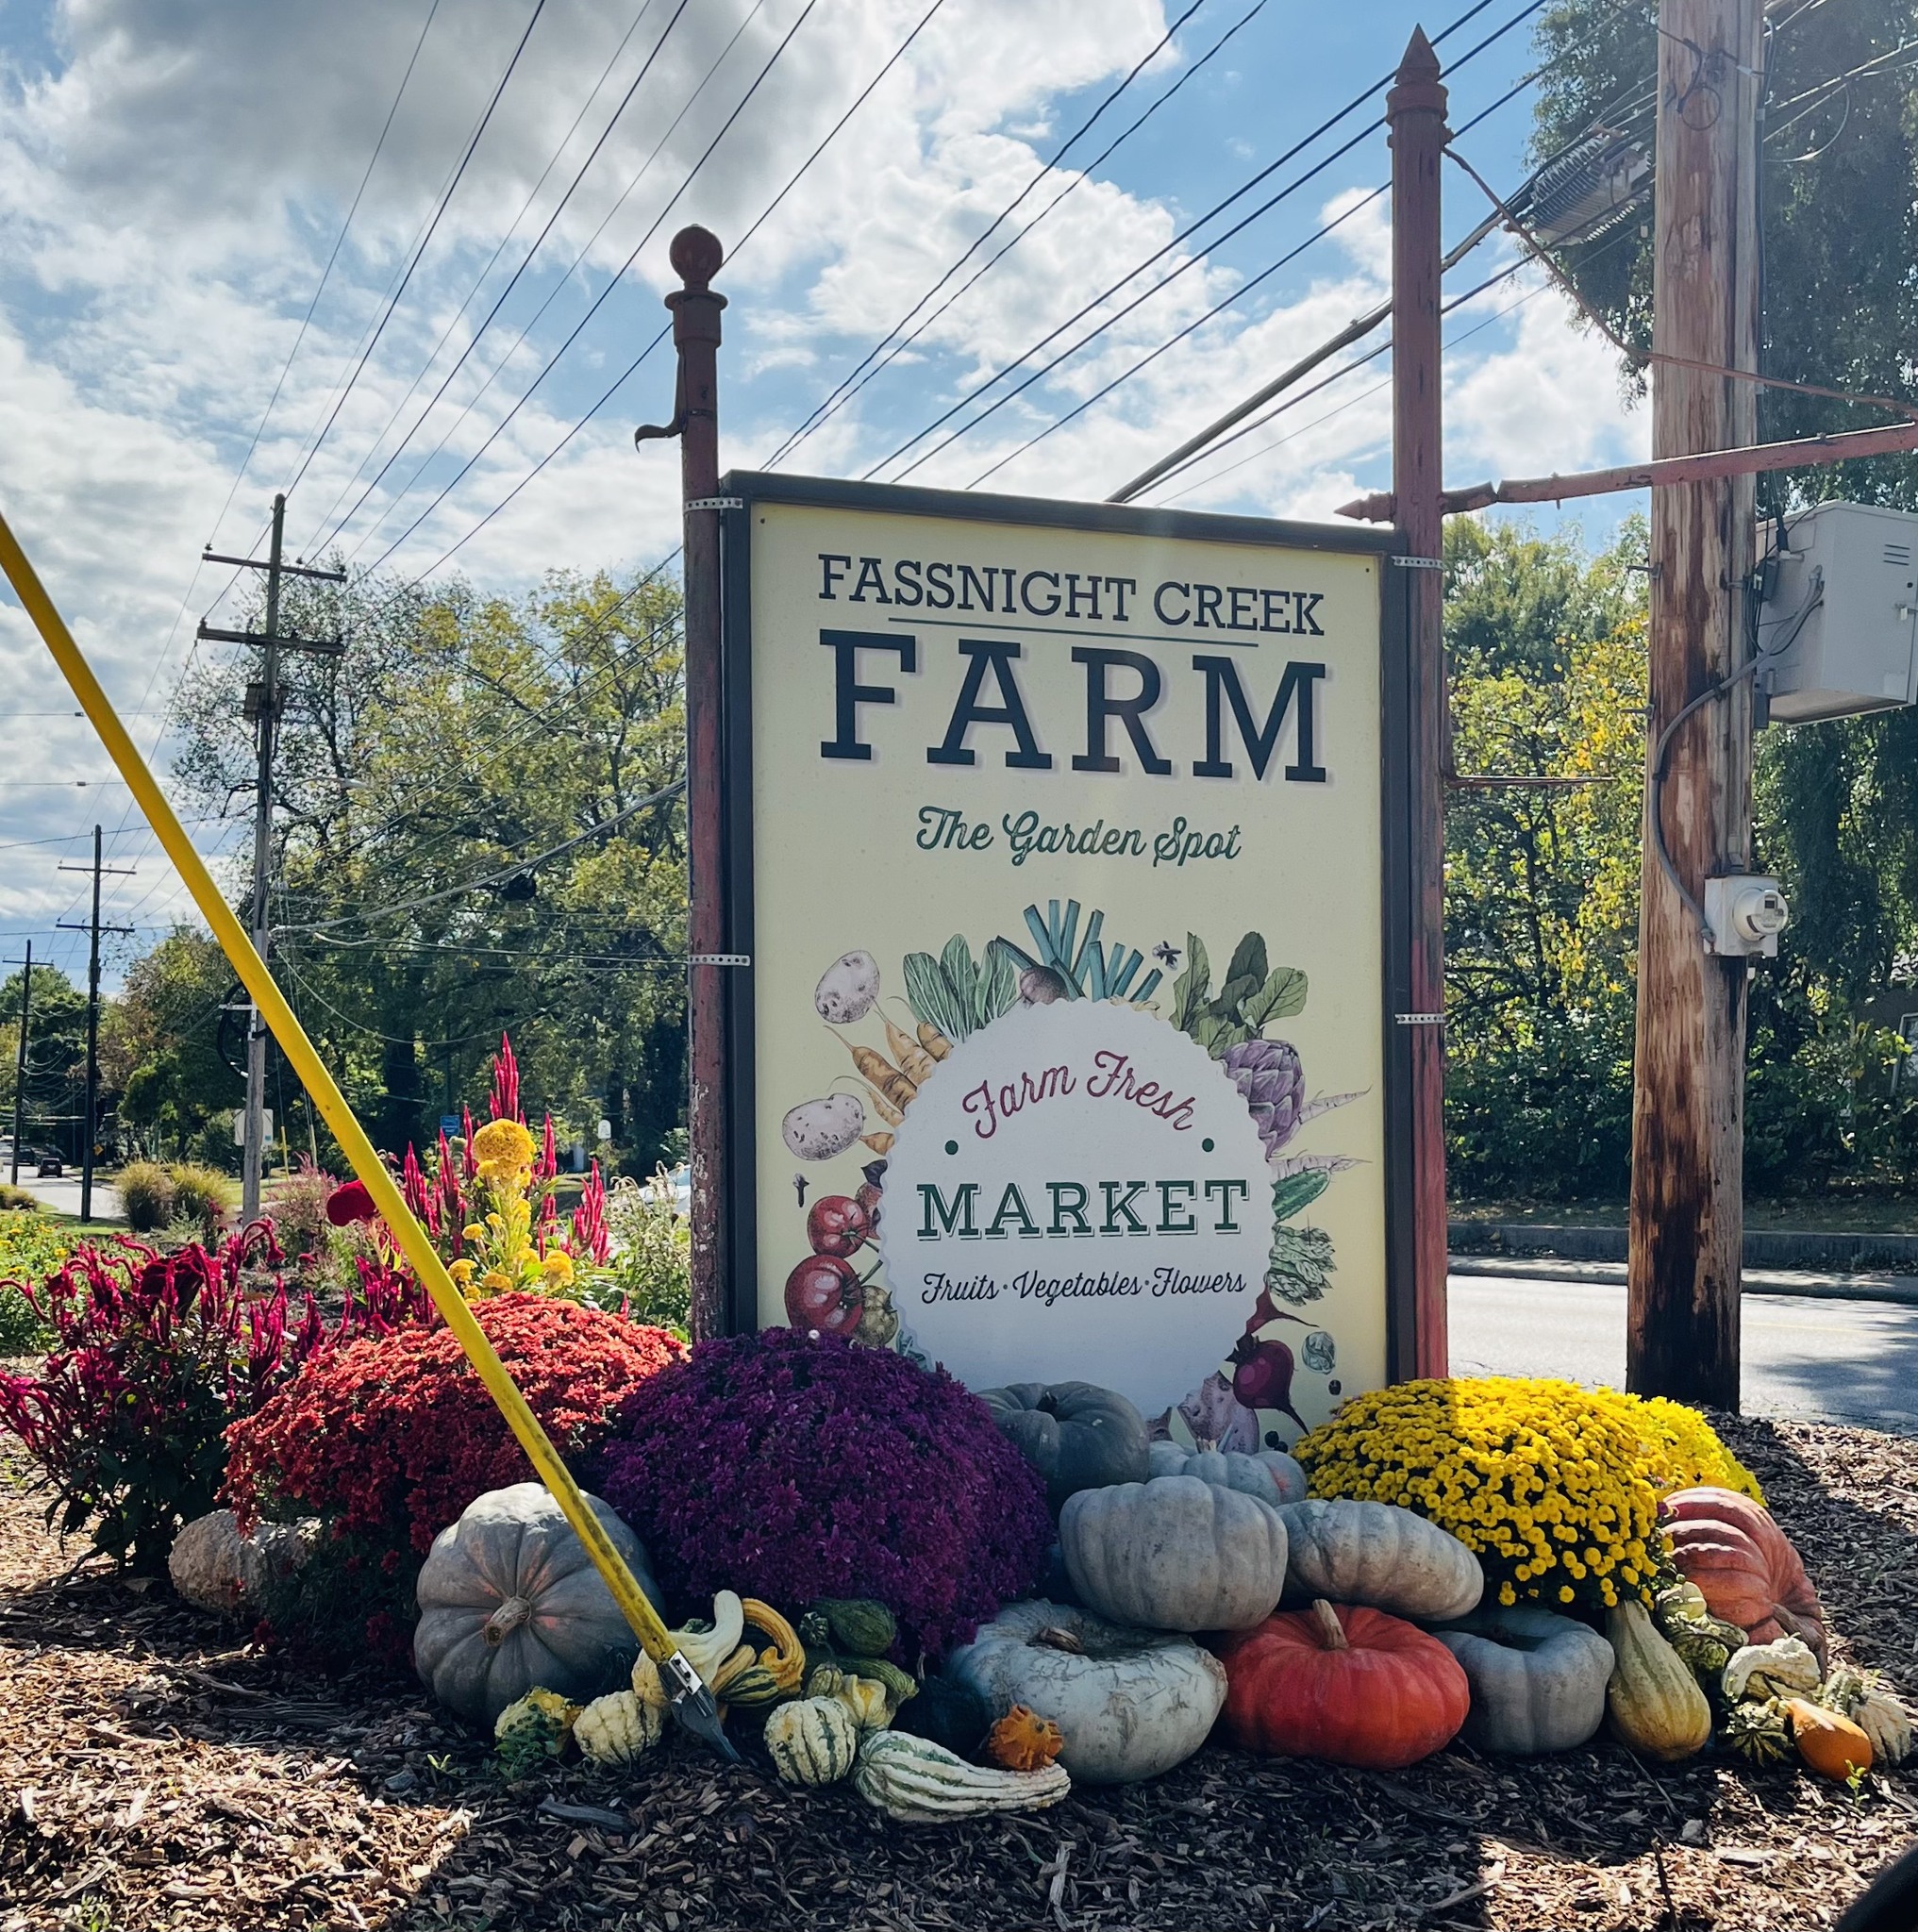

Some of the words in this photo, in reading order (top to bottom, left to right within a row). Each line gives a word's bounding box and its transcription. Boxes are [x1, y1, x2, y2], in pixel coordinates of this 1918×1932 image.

[818, 554, 1136, 622] FASSNIGHT
[1153, 581, 1325, 636] CREEK
[819, 629, 1326, 782] FARM
[917, 806, 993, 850] The
[1002, 810, 1146, 866] Garden
[1153, 817, 1241, 867] Spot
[961, 1064, 1076, 1139] Farm
[1086, 1050, 1196, 1130] Fresh
[916, 1179, 1250, 1241] MARKET
[921, 1273, 999, 1305] Fruits
[1012, 1270, 1142, 1307] Vegetables
[1151, 1267, 1247, 1297] Flowers
